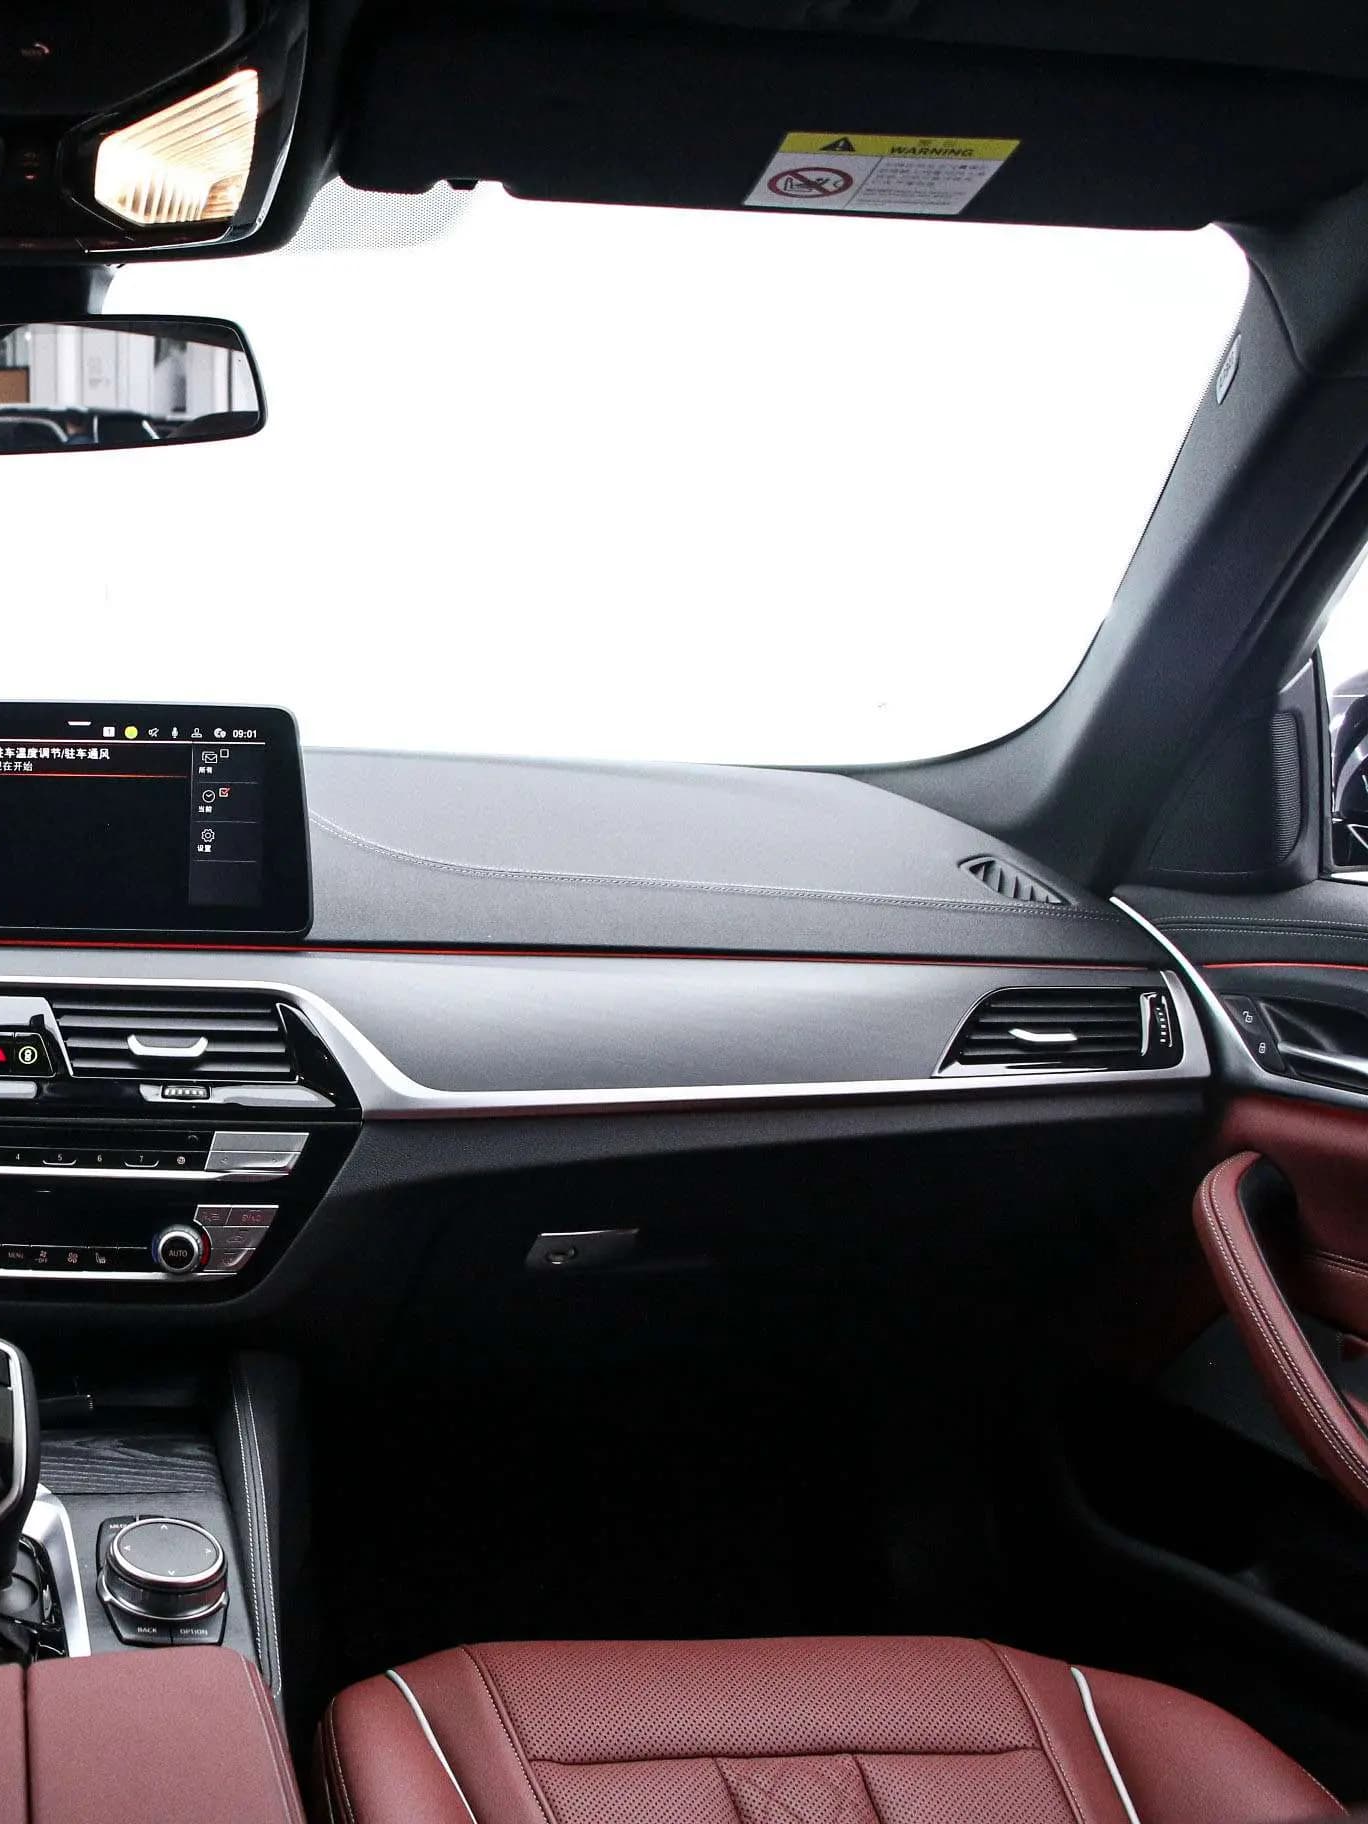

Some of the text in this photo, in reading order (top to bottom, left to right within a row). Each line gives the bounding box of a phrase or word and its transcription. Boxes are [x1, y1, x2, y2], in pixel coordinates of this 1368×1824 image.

[890, 146, 974, 157] WARNING
[232, 729, 257, 739] 09:01
[168, 1250, 188, 1258] AUTO
[179, 1628, 208, 1636] OPTION
